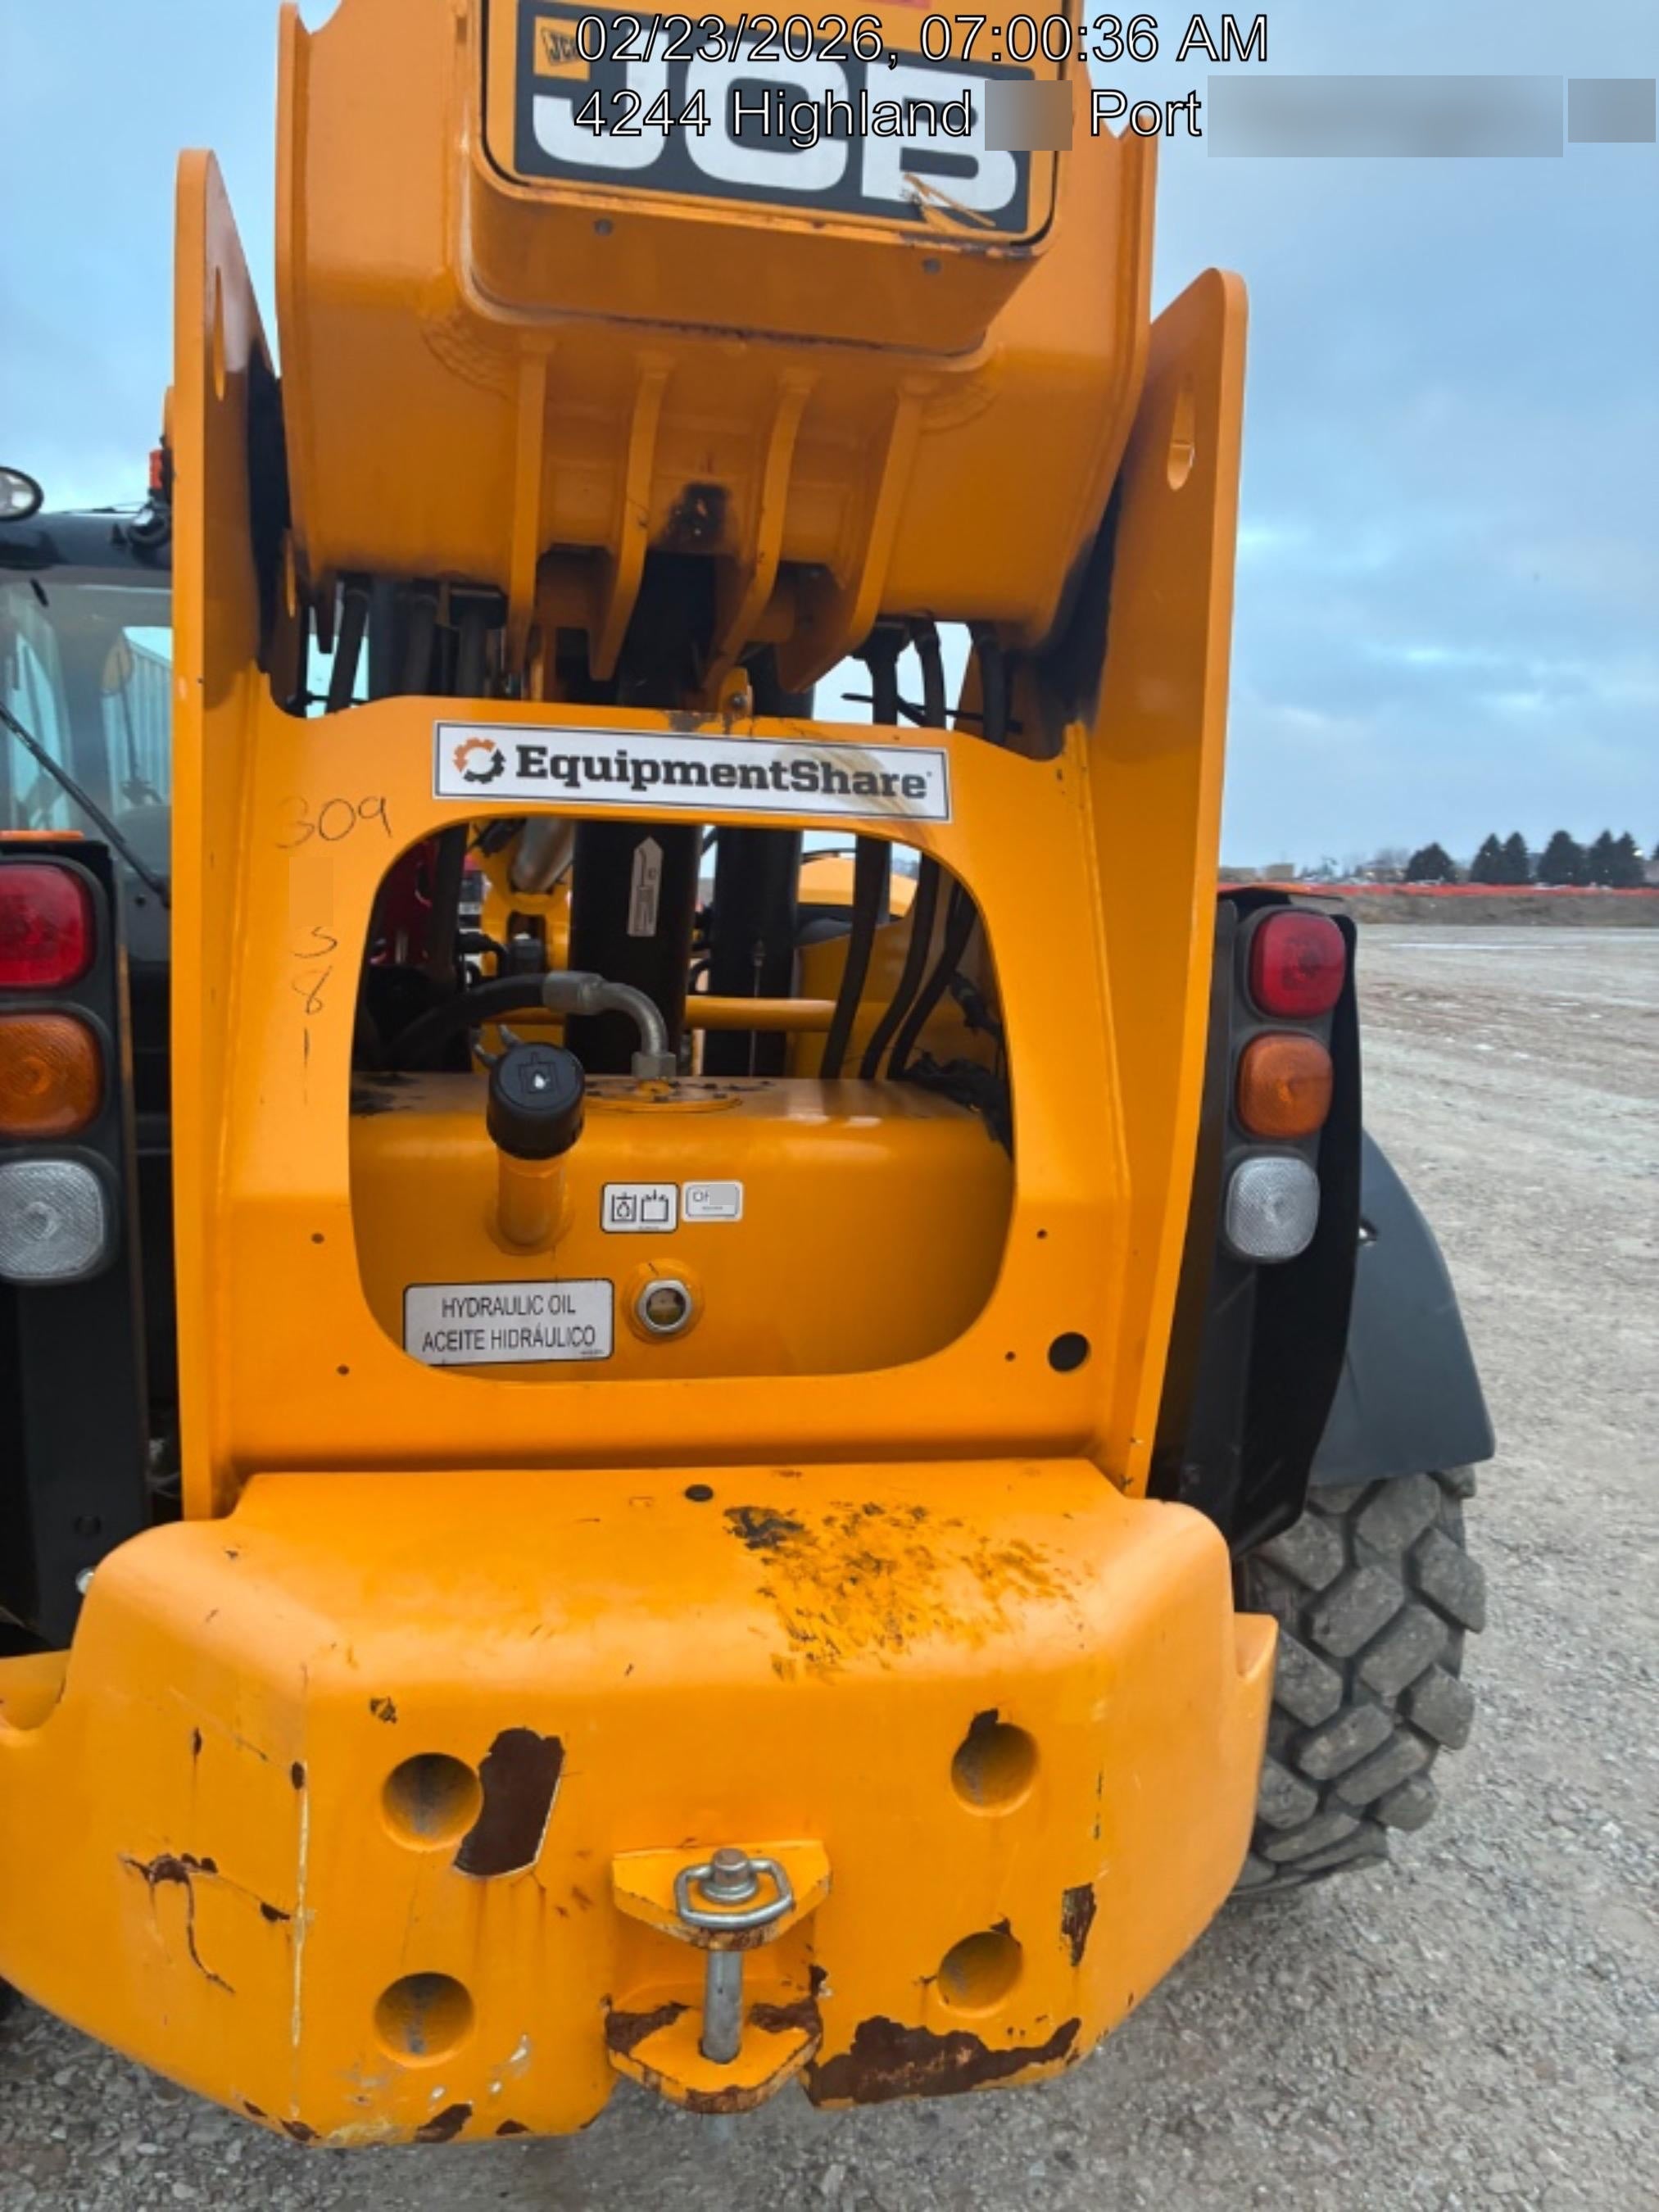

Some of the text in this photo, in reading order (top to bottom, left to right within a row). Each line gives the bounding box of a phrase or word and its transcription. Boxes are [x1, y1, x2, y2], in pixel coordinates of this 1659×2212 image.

[532, 25, 1018, 212] JCB
[515, 742, 927, 800] EquipmentShare
[275, 796, 392, 850] 309
[442, 1294, 576, 1318] HYDRAULIC OIL
[422, 1322, 596, 1352] ACEITE HIDRÁULICO
